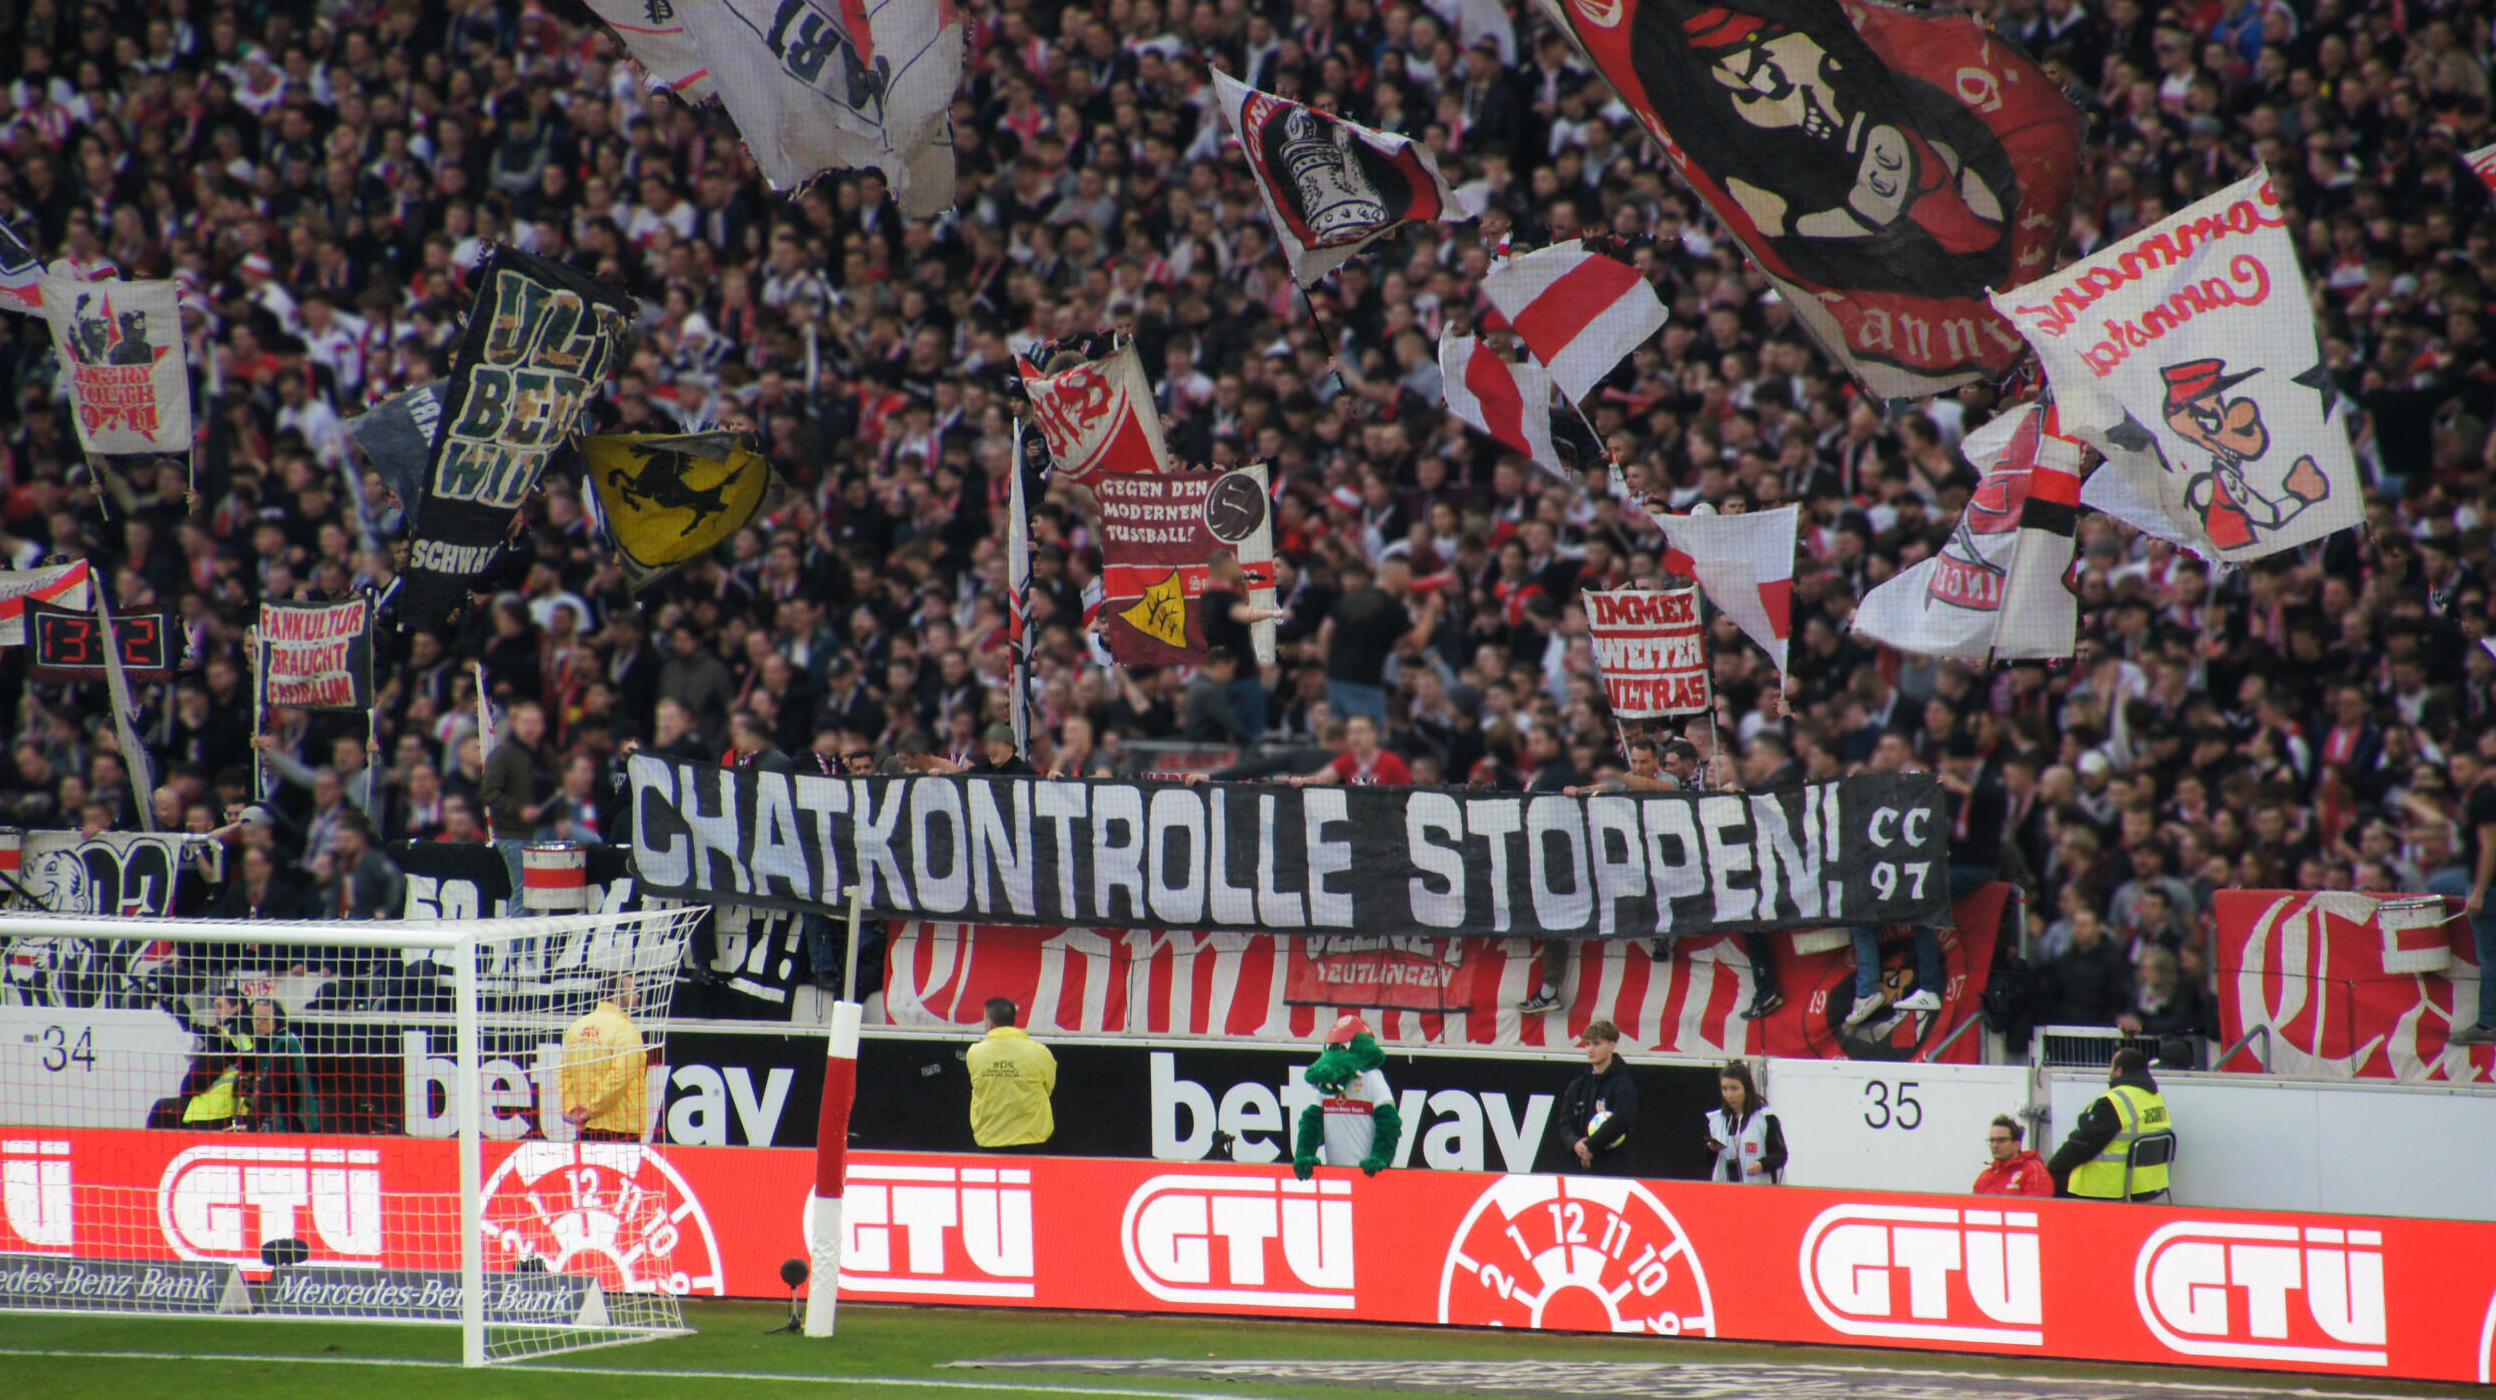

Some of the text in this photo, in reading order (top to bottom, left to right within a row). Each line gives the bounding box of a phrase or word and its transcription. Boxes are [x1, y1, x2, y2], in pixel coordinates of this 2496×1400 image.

[1102, 479, 1208, 497] GEGEN DEN
[1103, 502, 1203, 521] MODERNEN
[261, 604, 363, 640] FANKULTUR
[1592, 593, 1695, 625] IMMER
[271, 642, 345, 676] BRAUCHT
[1600, 636, 1704, 669] WEITER
[1604, 675, 1706, 711] ULTRAS
[628, 753, 1354, 929] CHATKONTROLLE
[1405, 781, 1844, 934] STOPPEN!
[1867, 806, 1931, 848] CC
[1869, 861, 1931, 901] 97
[1809, 990, 1828, 1014] 19
[43, 1025, 96, 1072] 34
[1864, 1080, 1922, 1130] 35
[170, 1148, 382, 1258] GTÜ
[565, 1168, 600, 1208] 12
[614, 1177, 642, 1221] 11
[644, 1207, 679, 1257] 10
[818, 1168, 1034, 1278] GTÜ
[1134, 1178, 1355, 1290] GTÜ
[1480, 1264, 1515, 1299] 2
[1505, 1224, 1532, 1261] 1
[1548, 1202, 1587, 1244] 12
[1600, 1212, 1632, 1259] 11
[1628, 1243, 1668, 1297] 10
[138, 1268, 215, 1299] Bank
[1813, 1209, 2043, 1326] GTÜ
[2149, 1226, 2387, 1346] GTÜ
[497, 1284, 572, 1312] Bank
